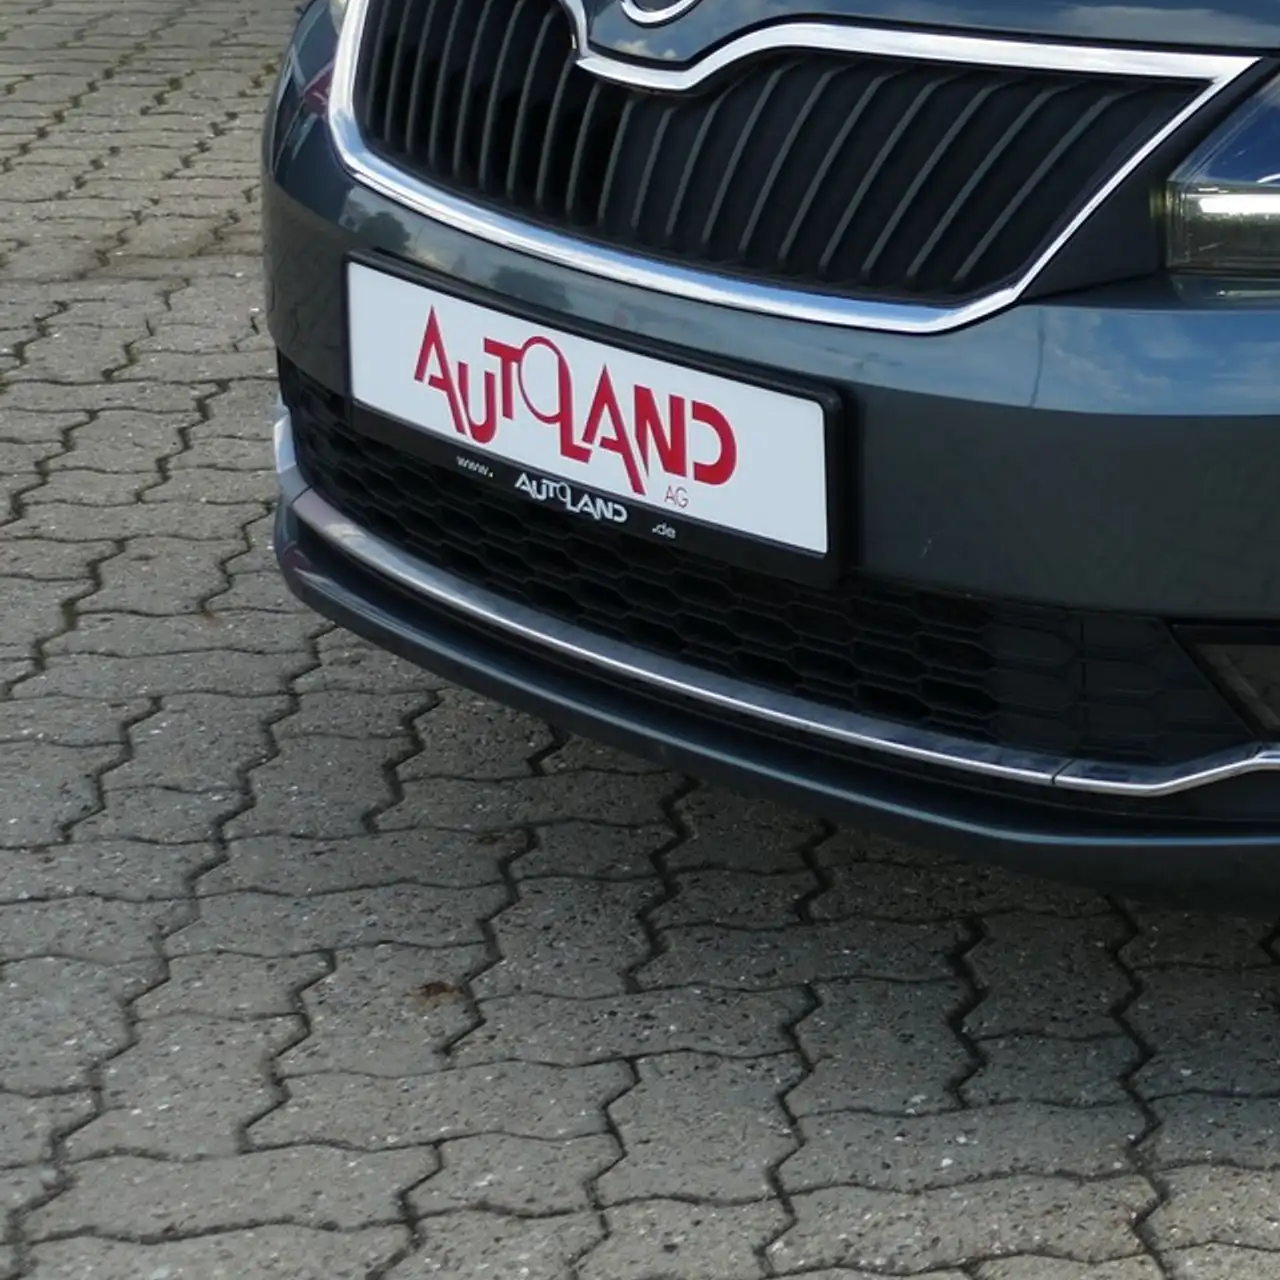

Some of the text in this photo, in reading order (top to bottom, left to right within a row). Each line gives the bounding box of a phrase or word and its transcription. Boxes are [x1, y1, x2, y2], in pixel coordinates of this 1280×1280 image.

[413, 305, 737, 495] AUTOLAND
[514, 472, 628, 523] AUTOLAND
[664, 485, 688, 509] AG
